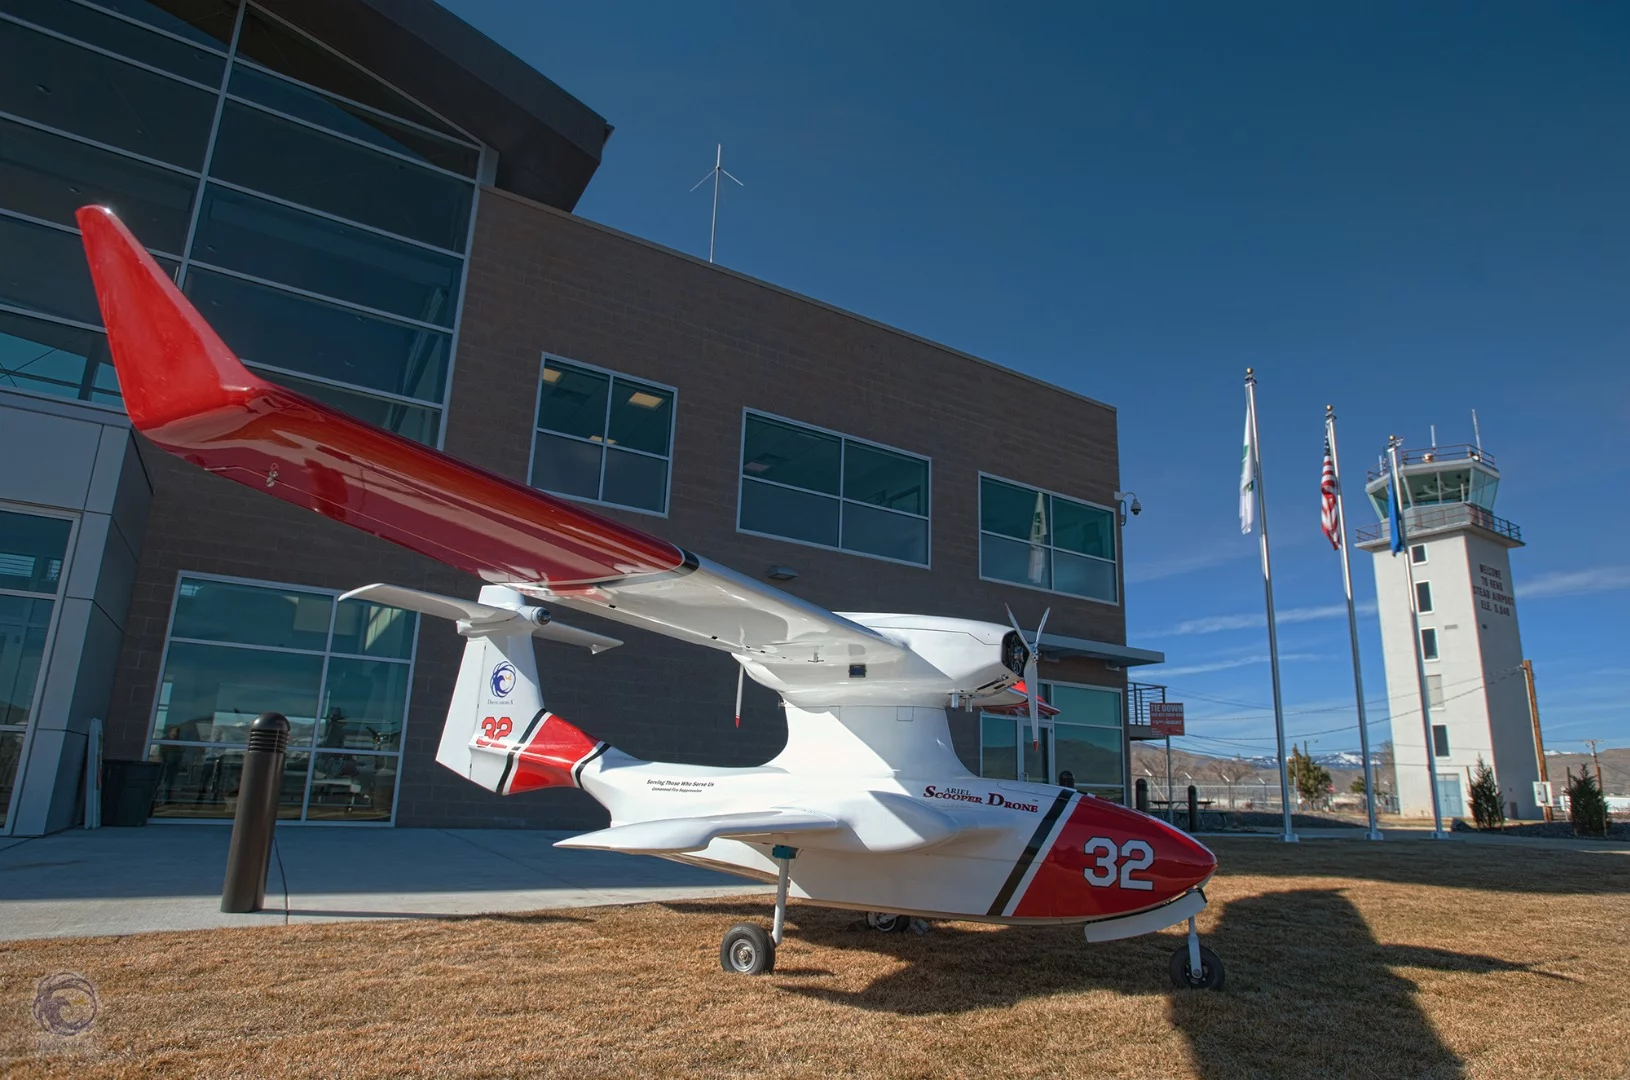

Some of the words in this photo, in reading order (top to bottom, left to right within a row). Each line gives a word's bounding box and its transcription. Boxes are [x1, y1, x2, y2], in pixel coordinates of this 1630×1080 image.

[1479, 564, 1501, 579] WELCOME
[1481, 576, 1488, 587] TO
[1490, 580, 1504, 591] RENO
[1473, 586, 1490, 599] STEAD
[1492, 592, 1514, 607] AIRPORT
[1151, 704, 1161, 712] TIE
[1162, 704, 1183, 712] DOWN
[476, 716, 513, 748] 32
[944, 787, 971, 796] ARIEL
[1083, 836, 1155, 891] 32
